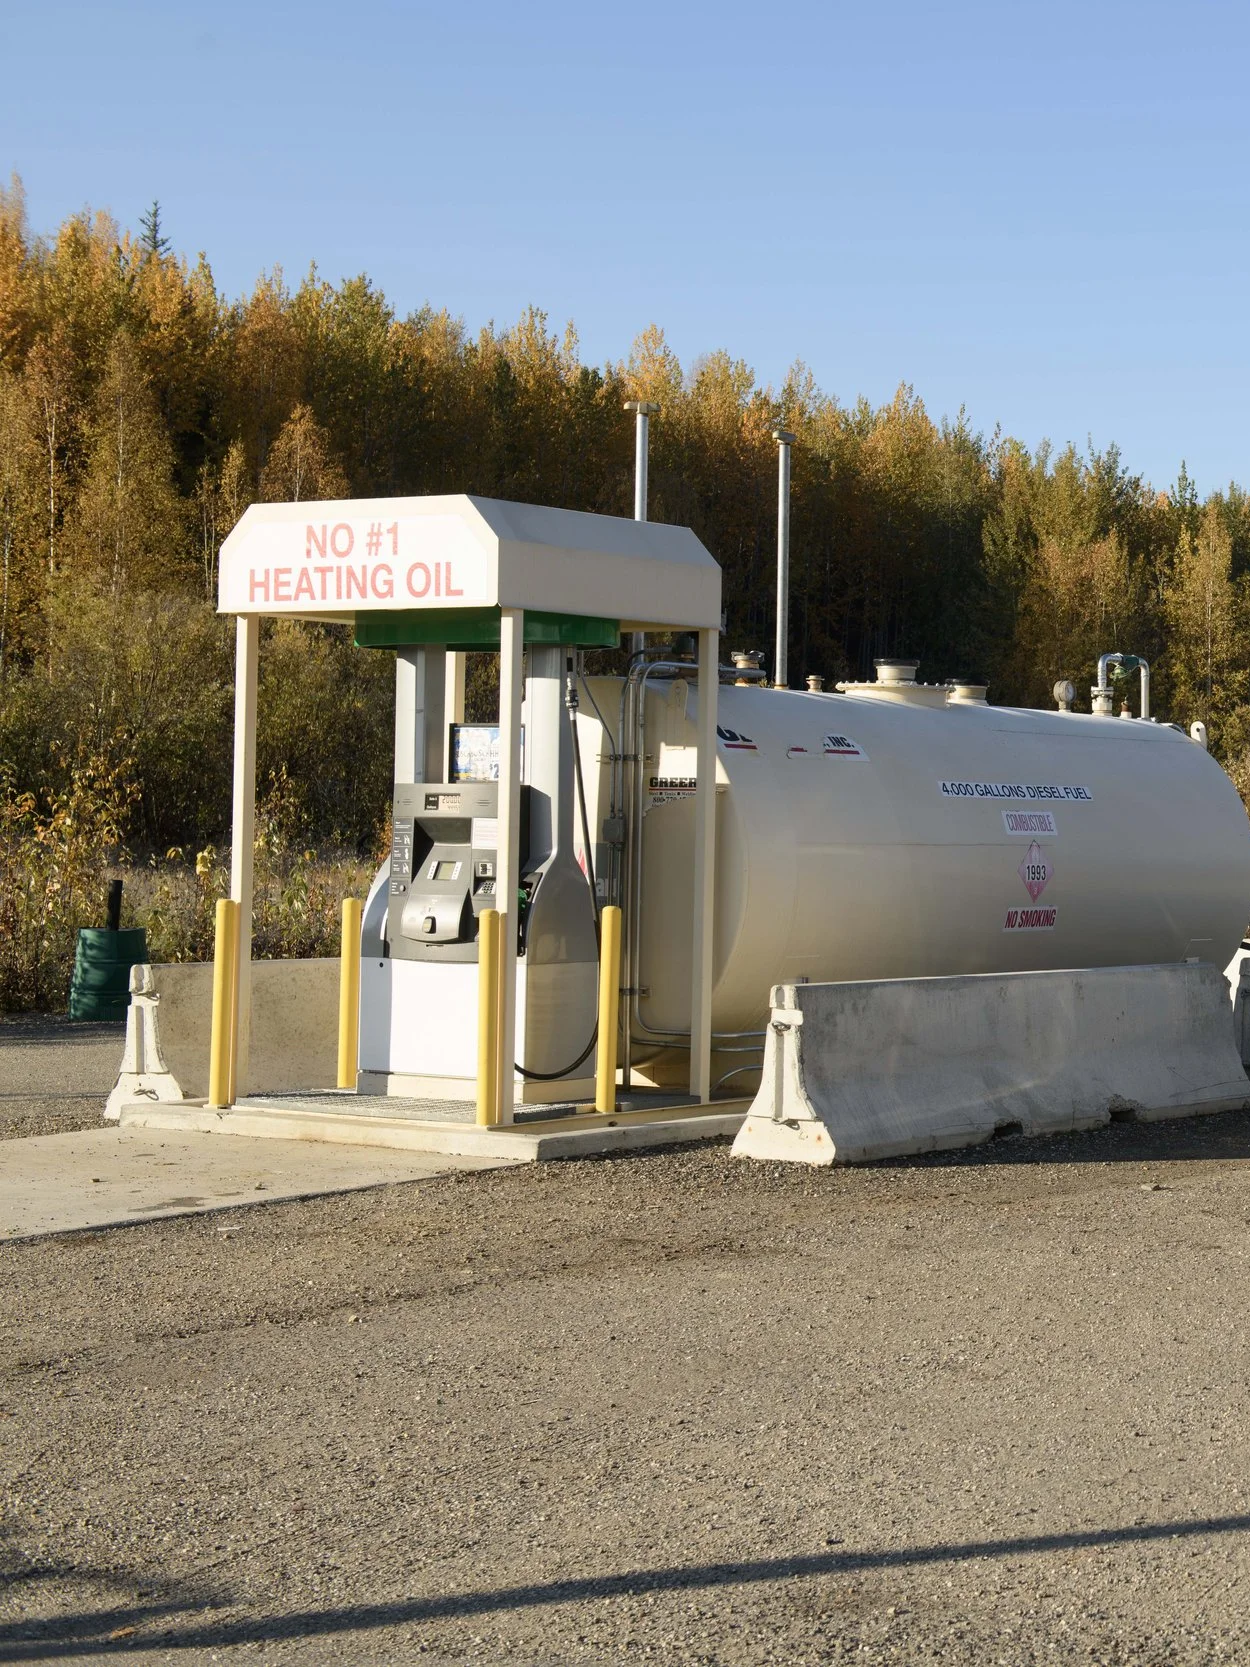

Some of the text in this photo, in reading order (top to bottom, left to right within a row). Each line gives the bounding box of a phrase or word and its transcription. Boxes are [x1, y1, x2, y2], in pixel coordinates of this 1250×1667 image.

[306, 521, 398, 558] NO #1
[249, 561, 463, 602] HEATING OIL
[650, 777, 697, 788] GREER
[975, 784, 1026, 798] GALLONS
[1026, 786, 1065, 799] DIESEL
[1064, 787, 1092, 800] FUEL
[1005, 814, 1054, 832] COMBUSTIBLE
[1026, 865, 1046, 881] 1993
[1004, 909, 1057, 928] NO SMOKING
